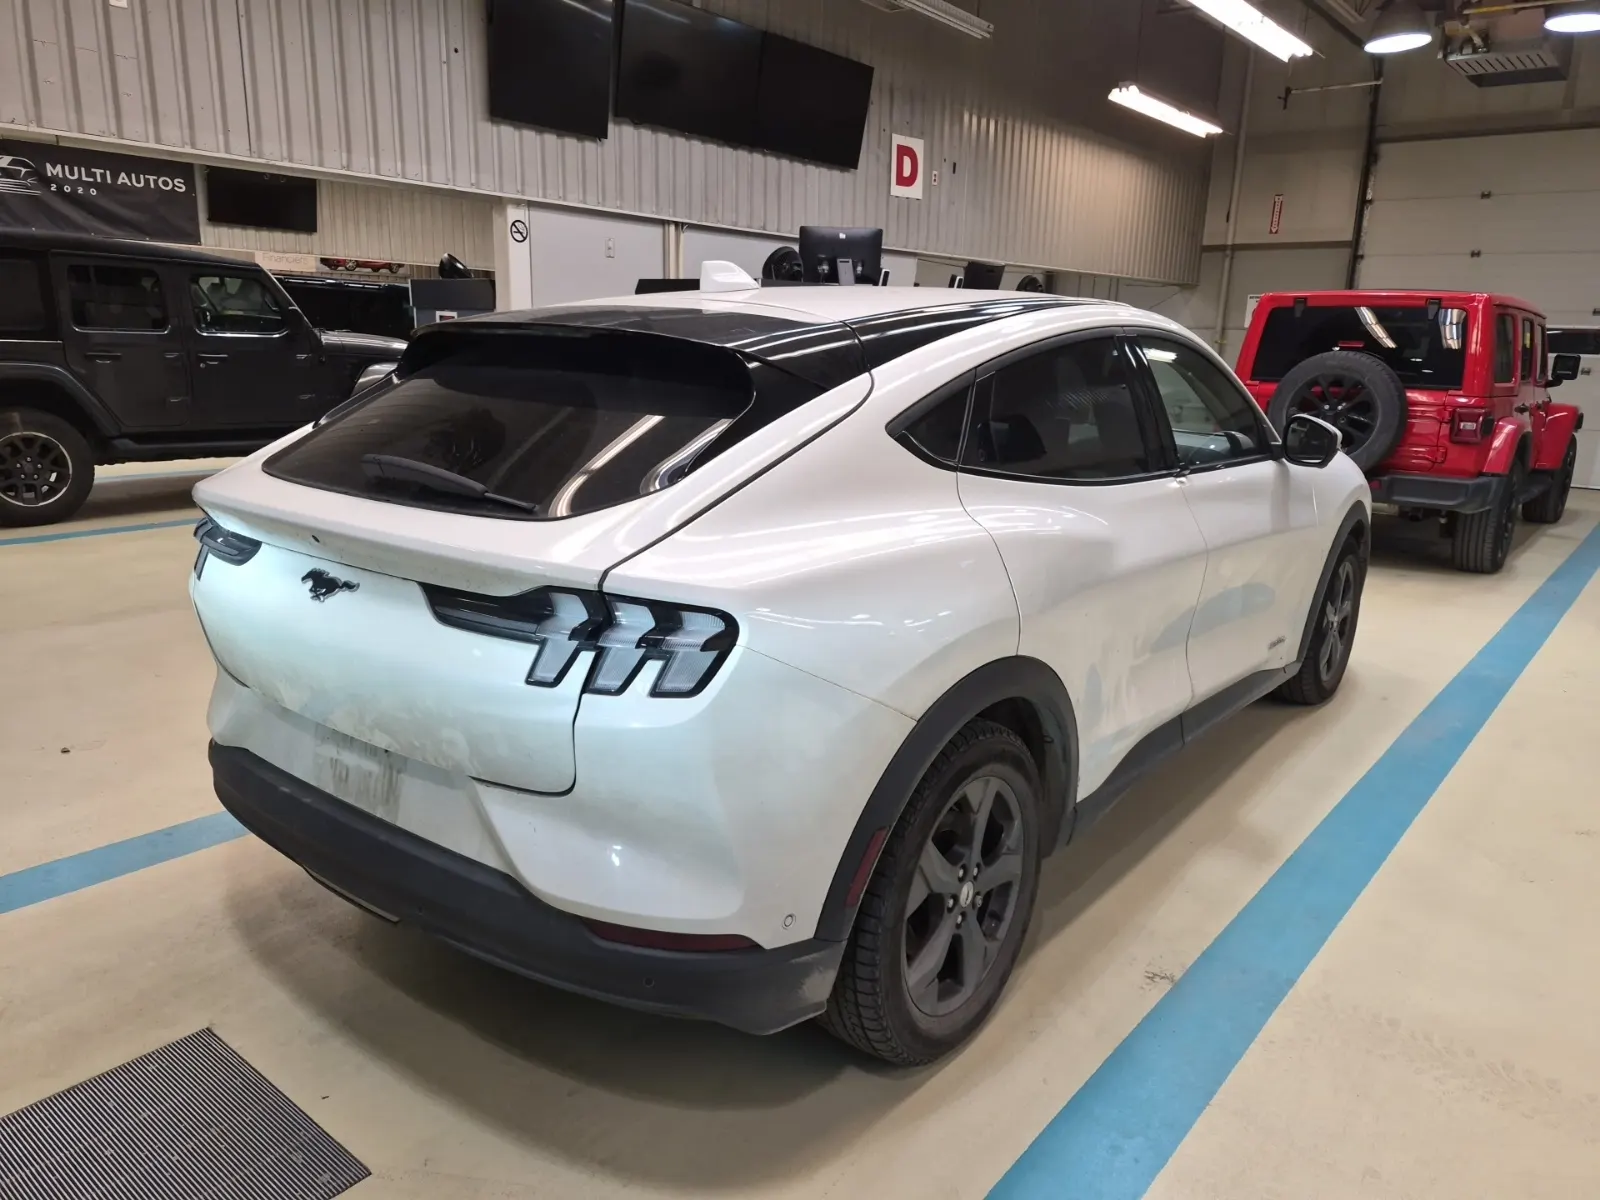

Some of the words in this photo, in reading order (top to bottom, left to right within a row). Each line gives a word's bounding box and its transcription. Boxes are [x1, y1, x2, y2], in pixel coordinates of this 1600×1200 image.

[45, 162, 112, 184] MULTI
[116, 172, 187, 193] AUTOS
[895, 143, 919, 187] D
[50, 183, 97, 196] 2020
